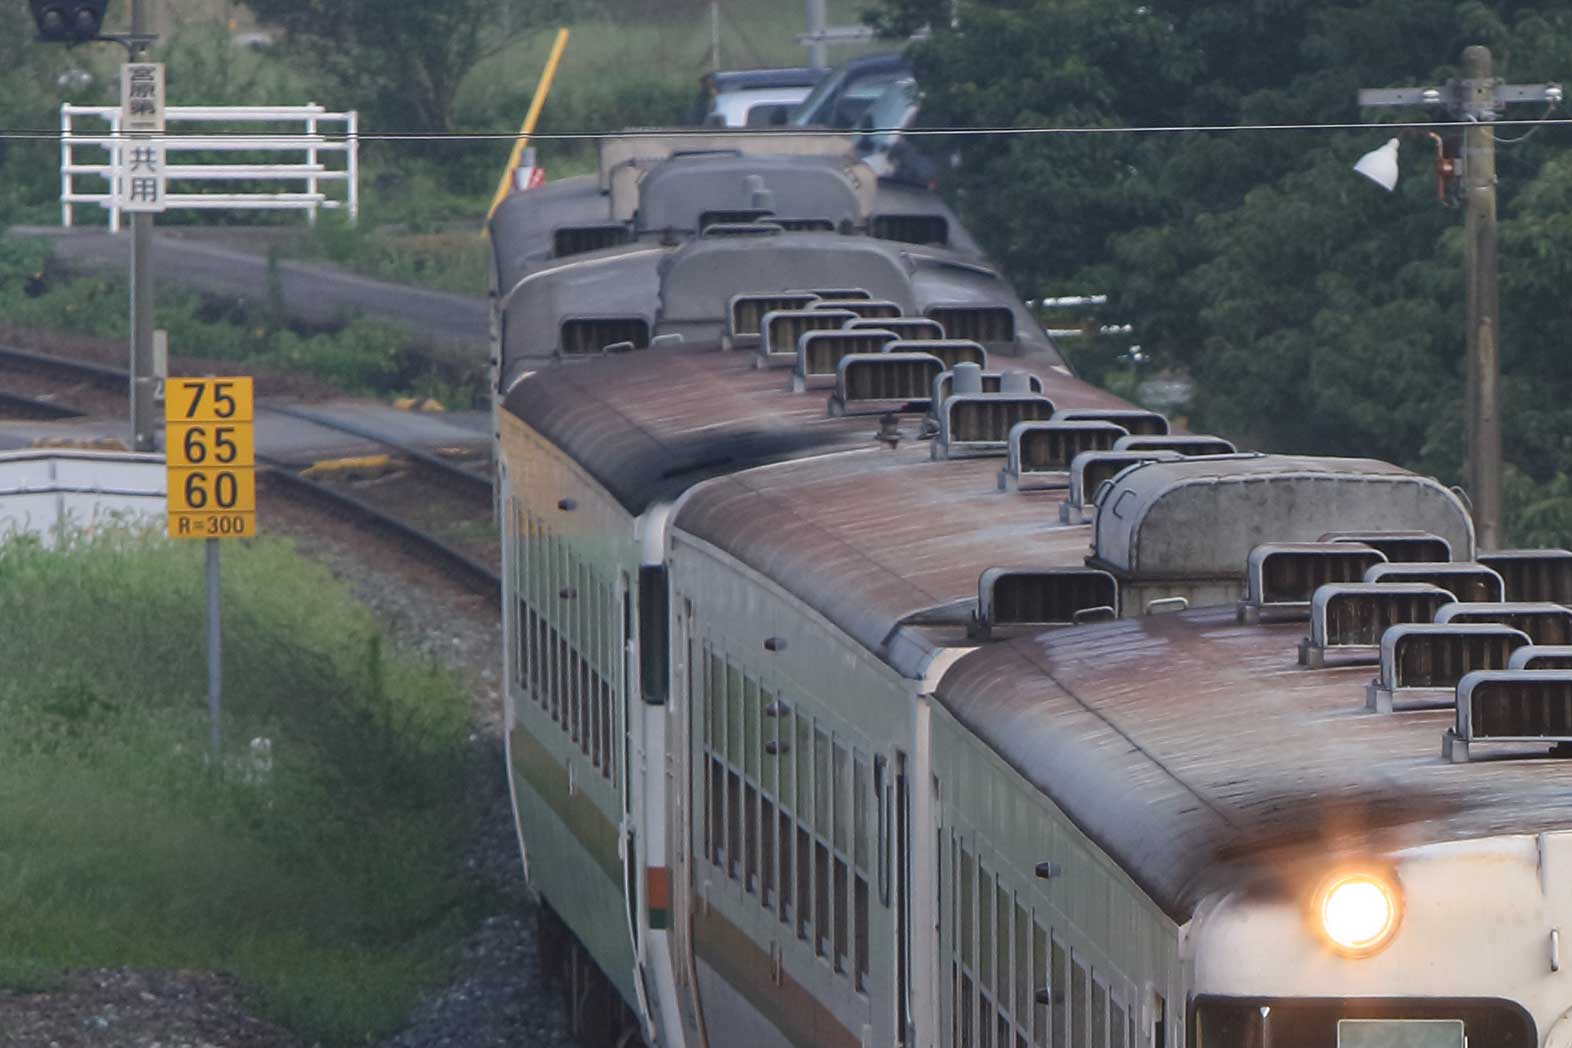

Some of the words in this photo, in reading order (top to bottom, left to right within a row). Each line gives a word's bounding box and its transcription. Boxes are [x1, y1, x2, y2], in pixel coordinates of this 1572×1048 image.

[183, 383, 236, 418] 75
[184, 426, 237, 464] 65
[185, 471, 238, 509] 60
[178, 515, 245, 535] R=300
